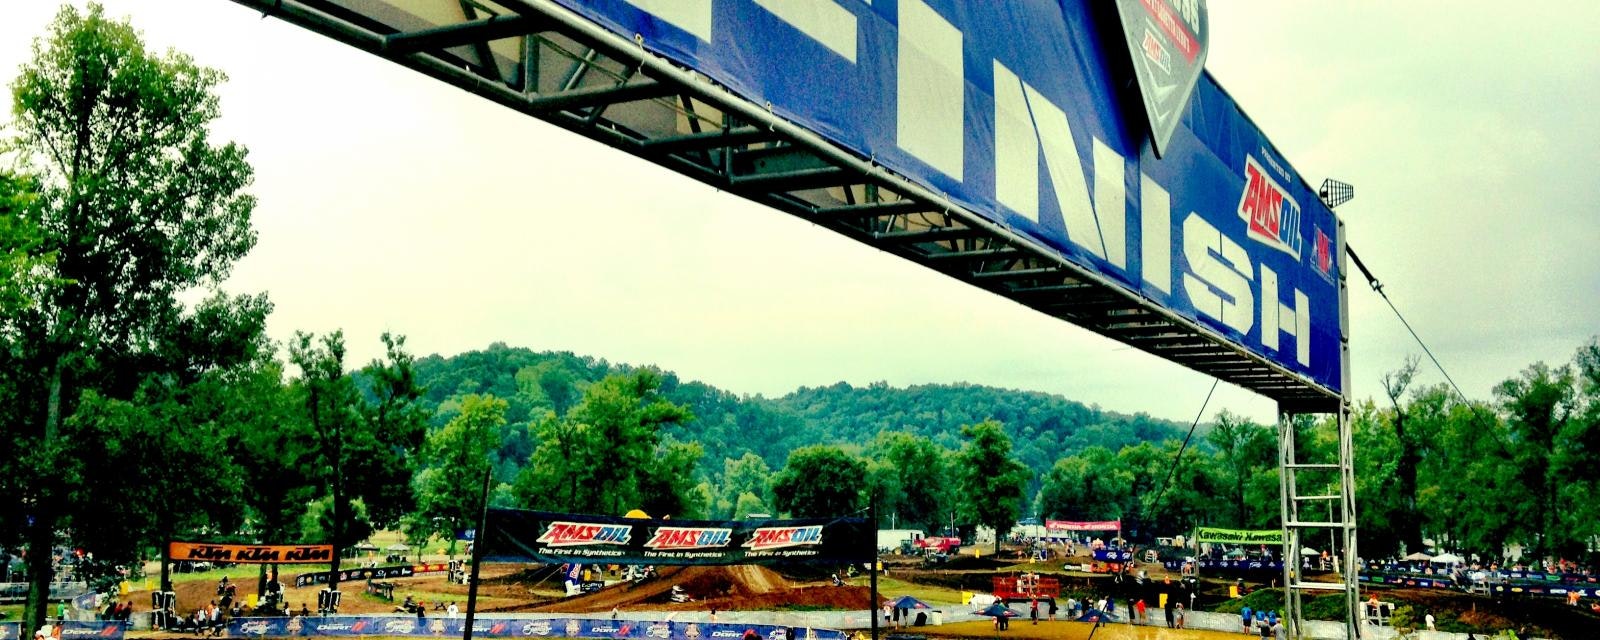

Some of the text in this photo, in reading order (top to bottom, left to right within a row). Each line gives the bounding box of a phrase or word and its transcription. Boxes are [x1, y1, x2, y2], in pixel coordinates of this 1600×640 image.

[1240, 158, 1302, 260] AMSOIL
[540, 523, 632, 546] AMSOIL
[646, 528, 731, 549] AMSOIL
[744, 526, 822, 549] AMSOIL
[1199, 529, 1243, 540] Kawasaki
[188, 545, 330, 560] KTM KTM KTM
[582, 549, 622, 557] Synthetics
